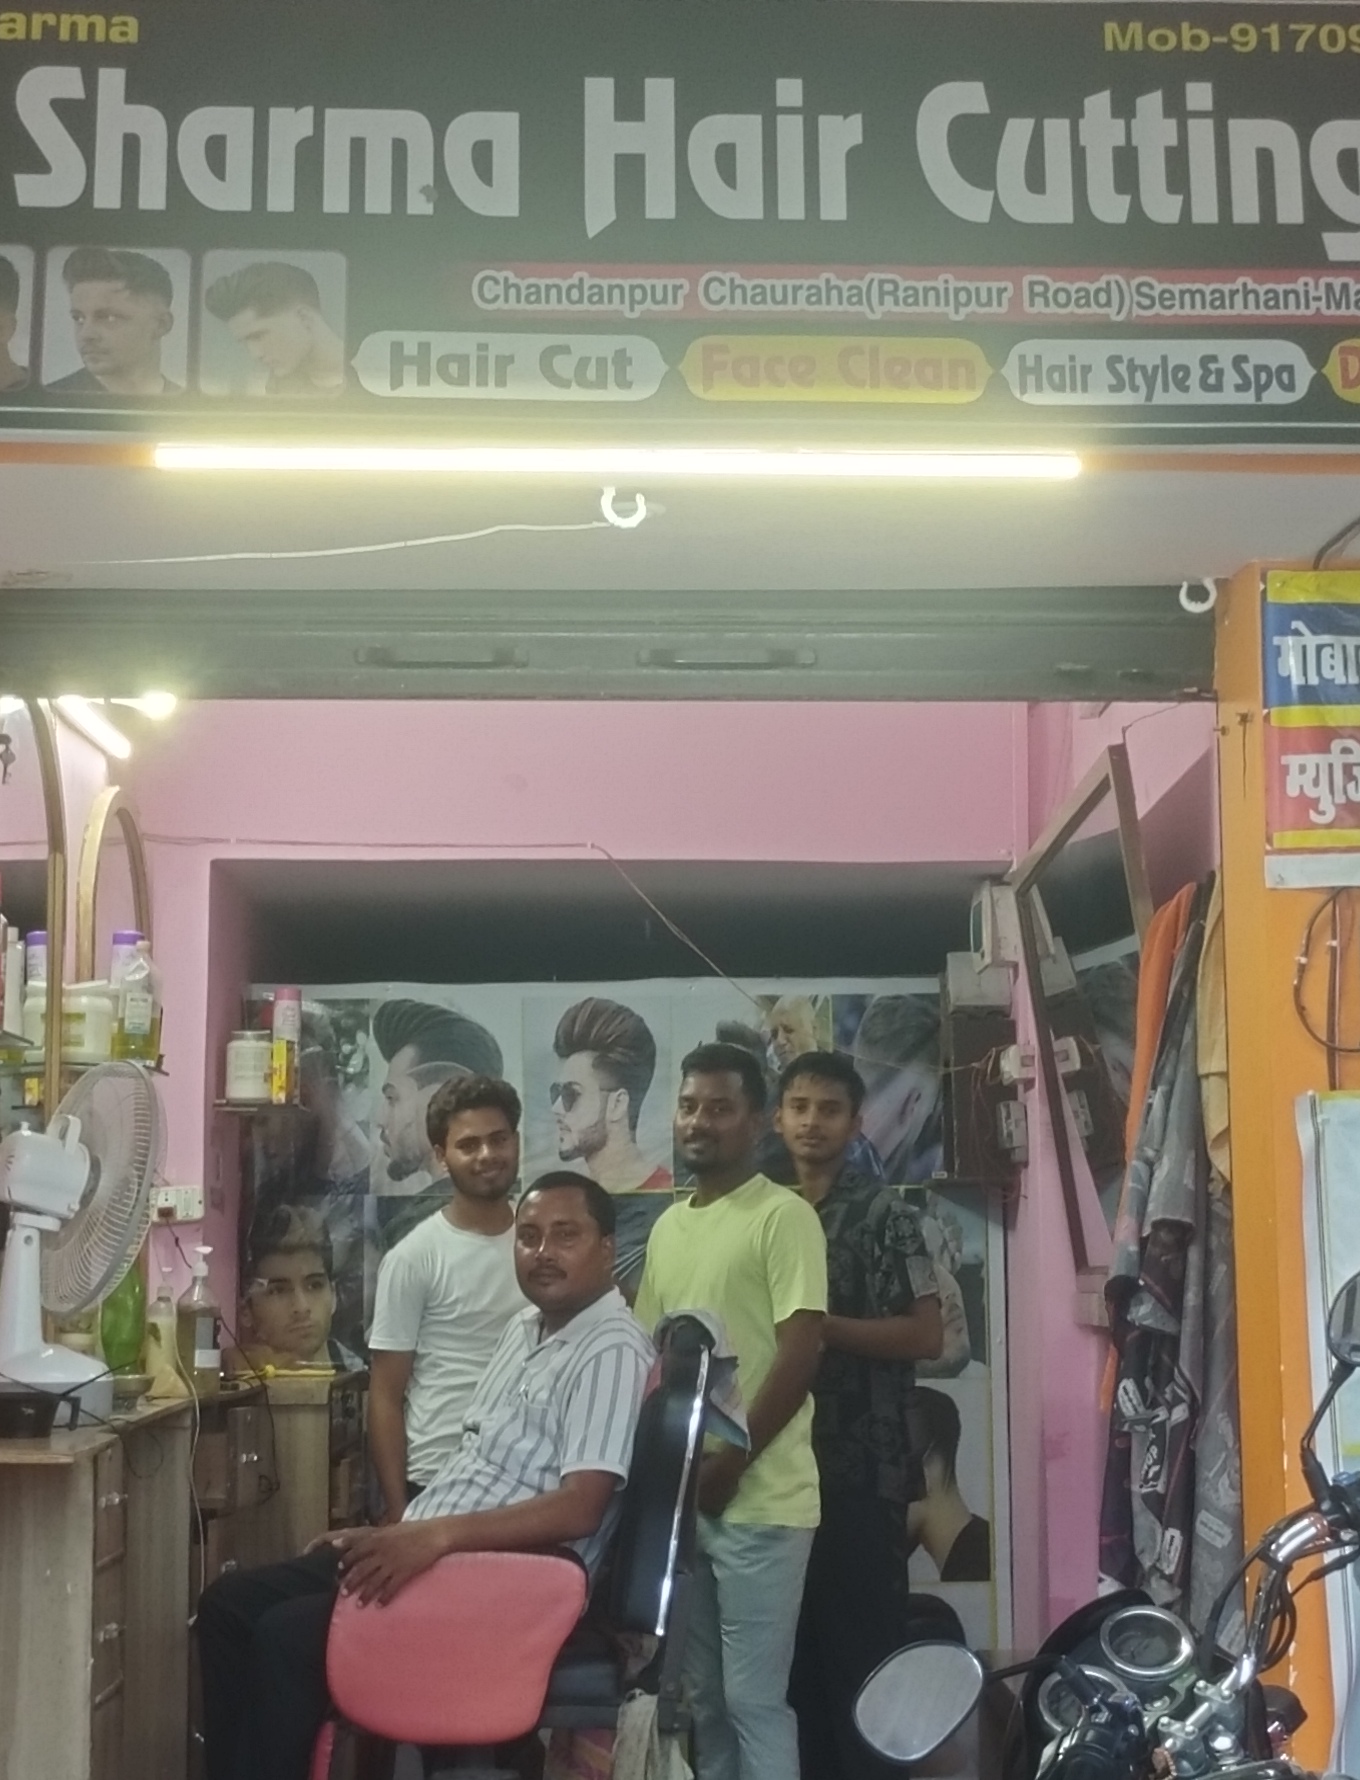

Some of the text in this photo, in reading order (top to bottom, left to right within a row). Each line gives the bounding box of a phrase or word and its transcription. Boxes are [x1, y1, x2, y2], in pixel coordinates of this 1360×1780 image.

[12, 64, 521, 217] Sharma
[583, 76, 864, 240] Hair
[475, 273, 686, 316] Chandanpur
[388, 339, 635, 392] Hair Cut
[701, 343, 979, 394] Face Clean
[1017, 353, 1092, 397] Hair
[1104, 353, 1191, 404] Style
[1230, 354, 1298, 403] Spa
